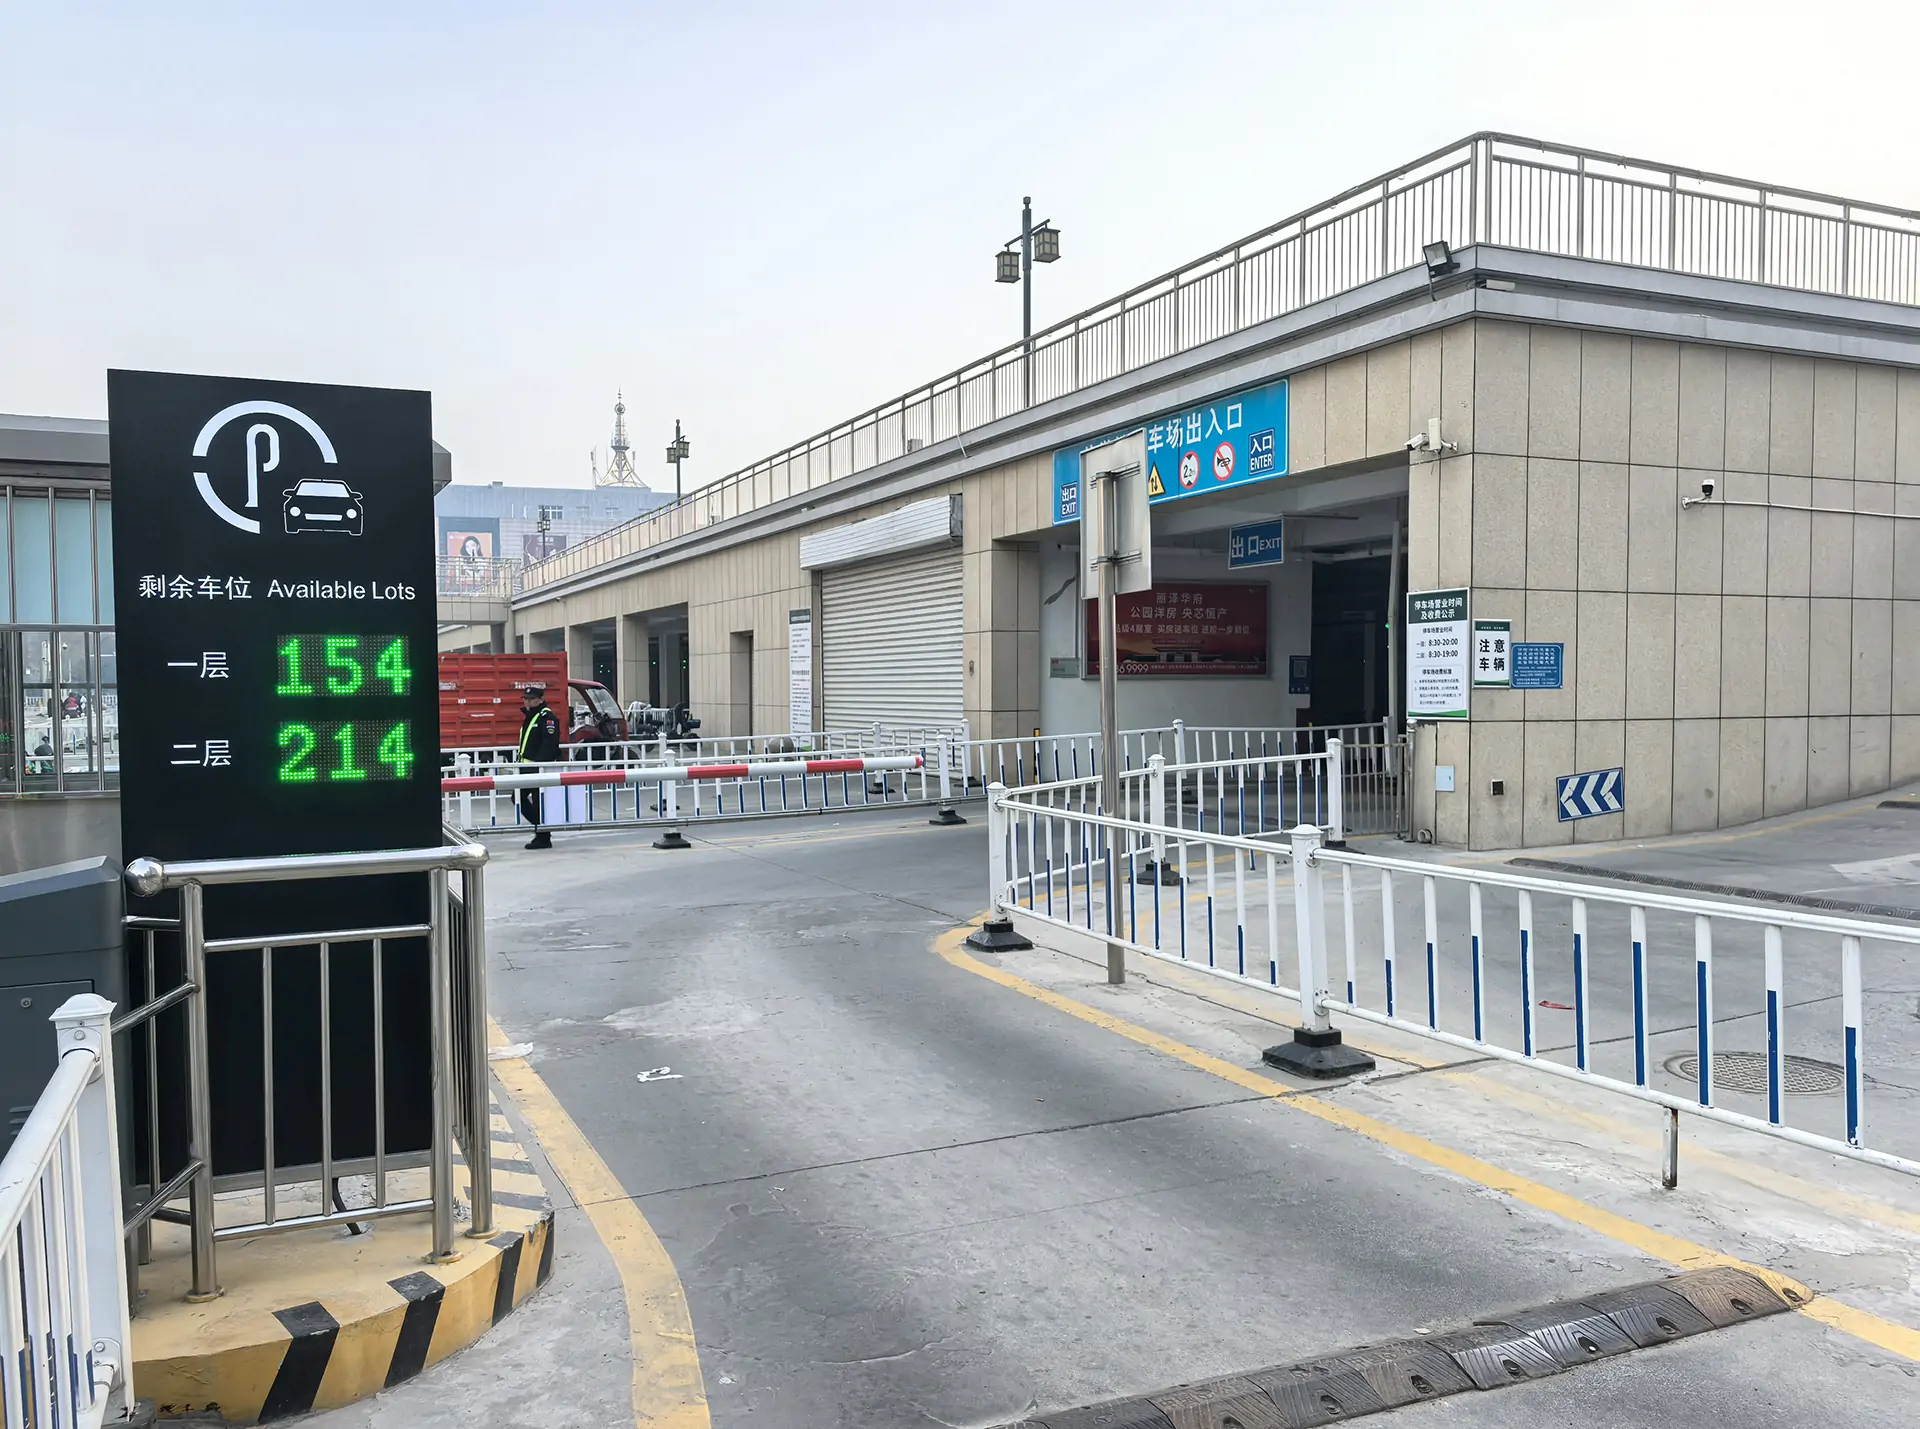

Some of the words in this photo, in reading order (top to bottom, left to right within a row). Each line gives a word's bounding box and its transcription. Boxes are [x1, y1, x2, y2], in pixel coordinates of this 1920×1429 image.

[1250, 434, 1272, 456] 入口
[1250, 453, 1273, 473] ENTER
[1061, 485, 1077, 503] 出口
[1061, 501, 1077, 516] EXIT
[1231, 535, 1260, 558] 出口
[1259, 537, 1281, 551] EXIT
[138, 574, 252, 601] 剩余车位
[267, 579, 366, 601] Available
[372, 581, 416, 602] Lots
[1156, 592, 1204, 605] 丽泽华府
[1414, 598, 1463, 610] 停车场营业时间
[1130, 606, 1177, 619] 公园洋房
[1420, 609, 1455, 620] 及收费公示
[1428, 638, 1459, 647] 8:30-20:00
[1479, 638, 1505, 653] 注意
[1428, 650, 1459, 659] 8:30-19:00
[167, 651, 230, 680] 一层
[275, 637, 413, 696] 154
[1127, 664, 1149, 674] 9999
[1479, 657, 1505, 671] 车辆
[169, 738, 232, 768] 二层
[277, 723, 415, 783] 214
